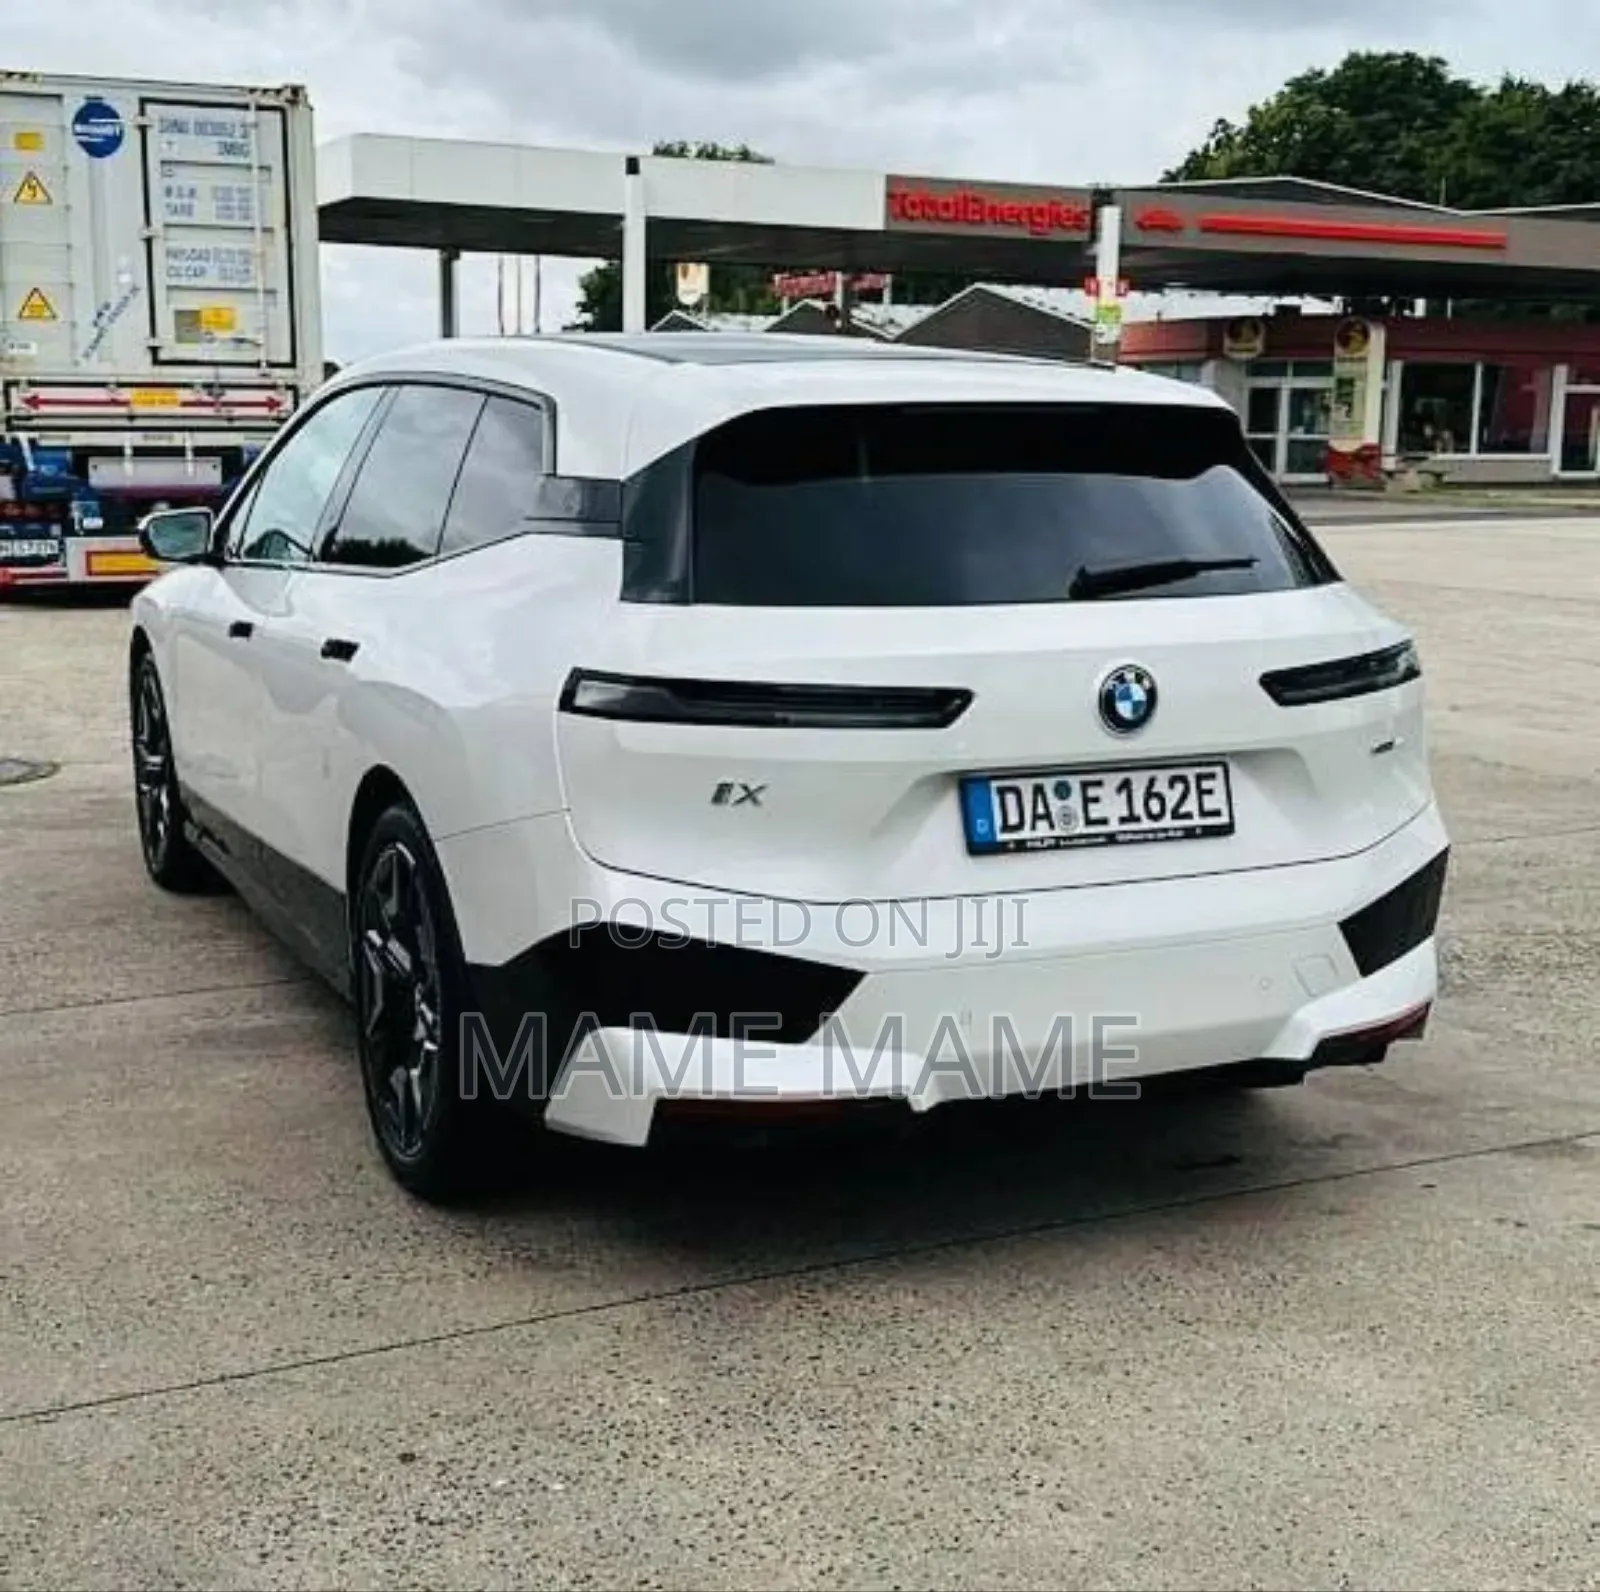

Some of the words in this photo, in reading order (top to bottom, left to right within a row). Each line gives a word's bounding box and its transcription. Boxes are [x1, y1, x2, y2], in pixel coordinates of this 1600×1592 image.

[887, 183, 1091, 236] TotalEnergies
[997, 783, 1055, 834] DA
[1080, 779, 1109, 827] E
[1115, 771, 1222, 825] 162E
